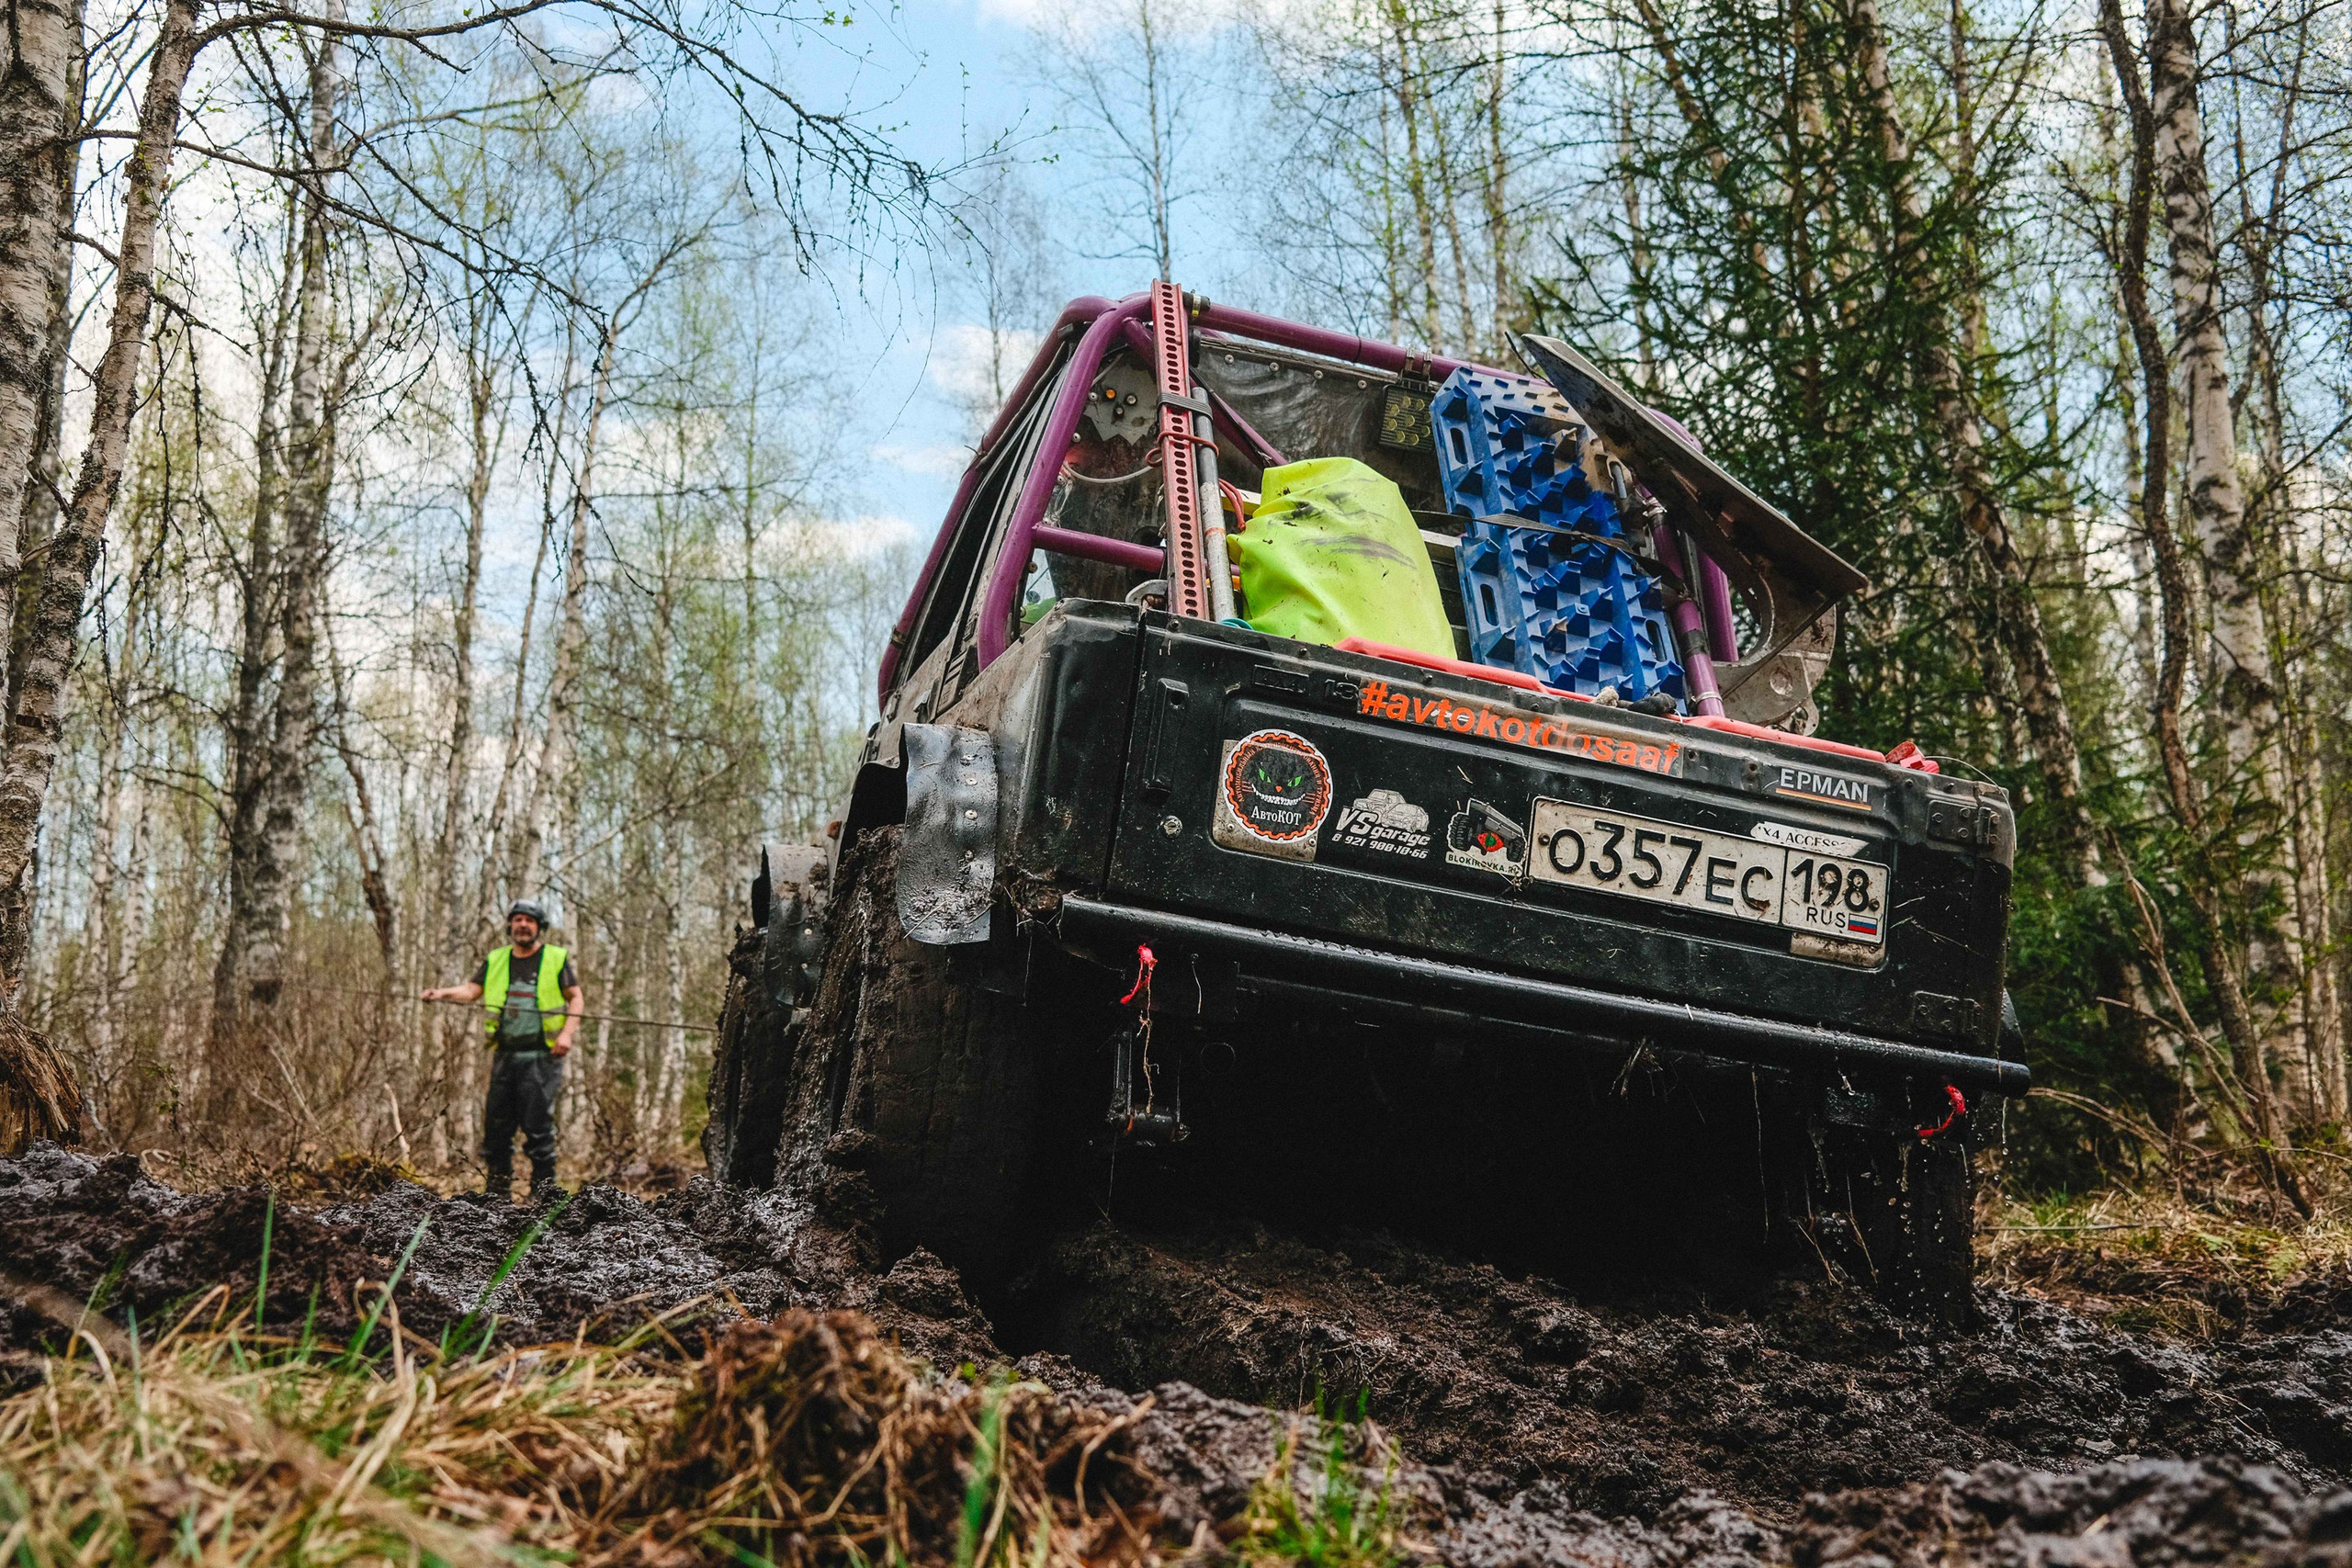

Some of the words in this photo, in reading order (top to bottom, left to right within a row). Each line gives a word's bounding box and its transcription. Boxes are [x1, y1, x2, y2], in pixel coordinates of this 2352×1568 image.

[1360, 680, 1679, 773] #avtokotdosaaf
[1780, 768, 1869, 803] EPMAN
[1251, 806, 1301, 825] АвтоКОТ
[1336, 806, 1380, 835] VS
[1370, 827, 1431, 846] garage
[1345, 835, 1366, 847] 921
[1791, 858, 1870, 912] 198
[1806, 907, 1846, 929] RUS
